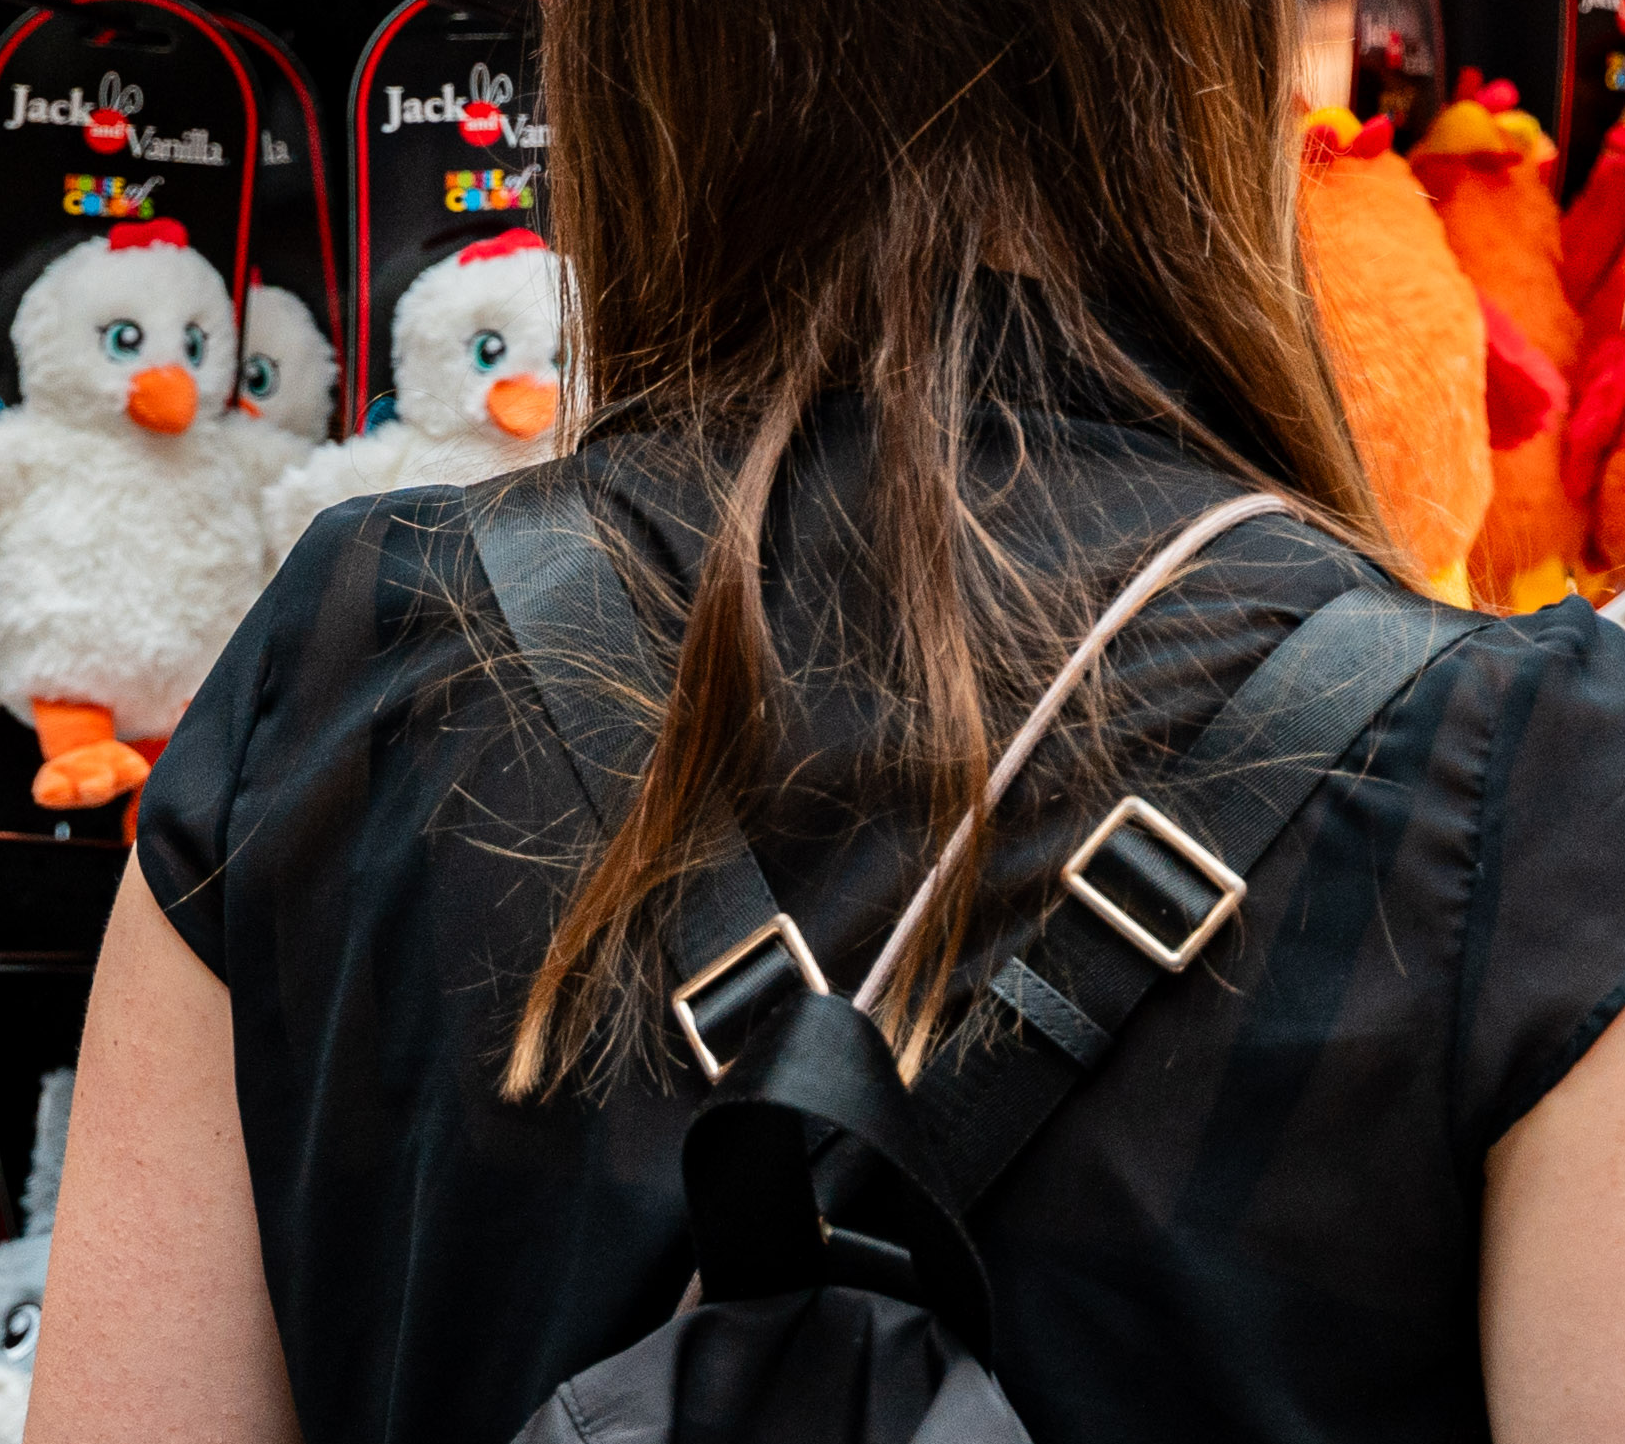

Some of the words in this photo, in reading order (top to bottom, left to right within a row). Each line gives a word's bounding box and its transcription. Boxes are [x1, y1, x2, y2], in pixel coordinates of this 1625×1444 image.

[4, 83, 96, 130] Jack
[125, 124, 225, 166] Vanilla
[381, 82, 469, 134] Jack
[464, 111, 498, 132] and
